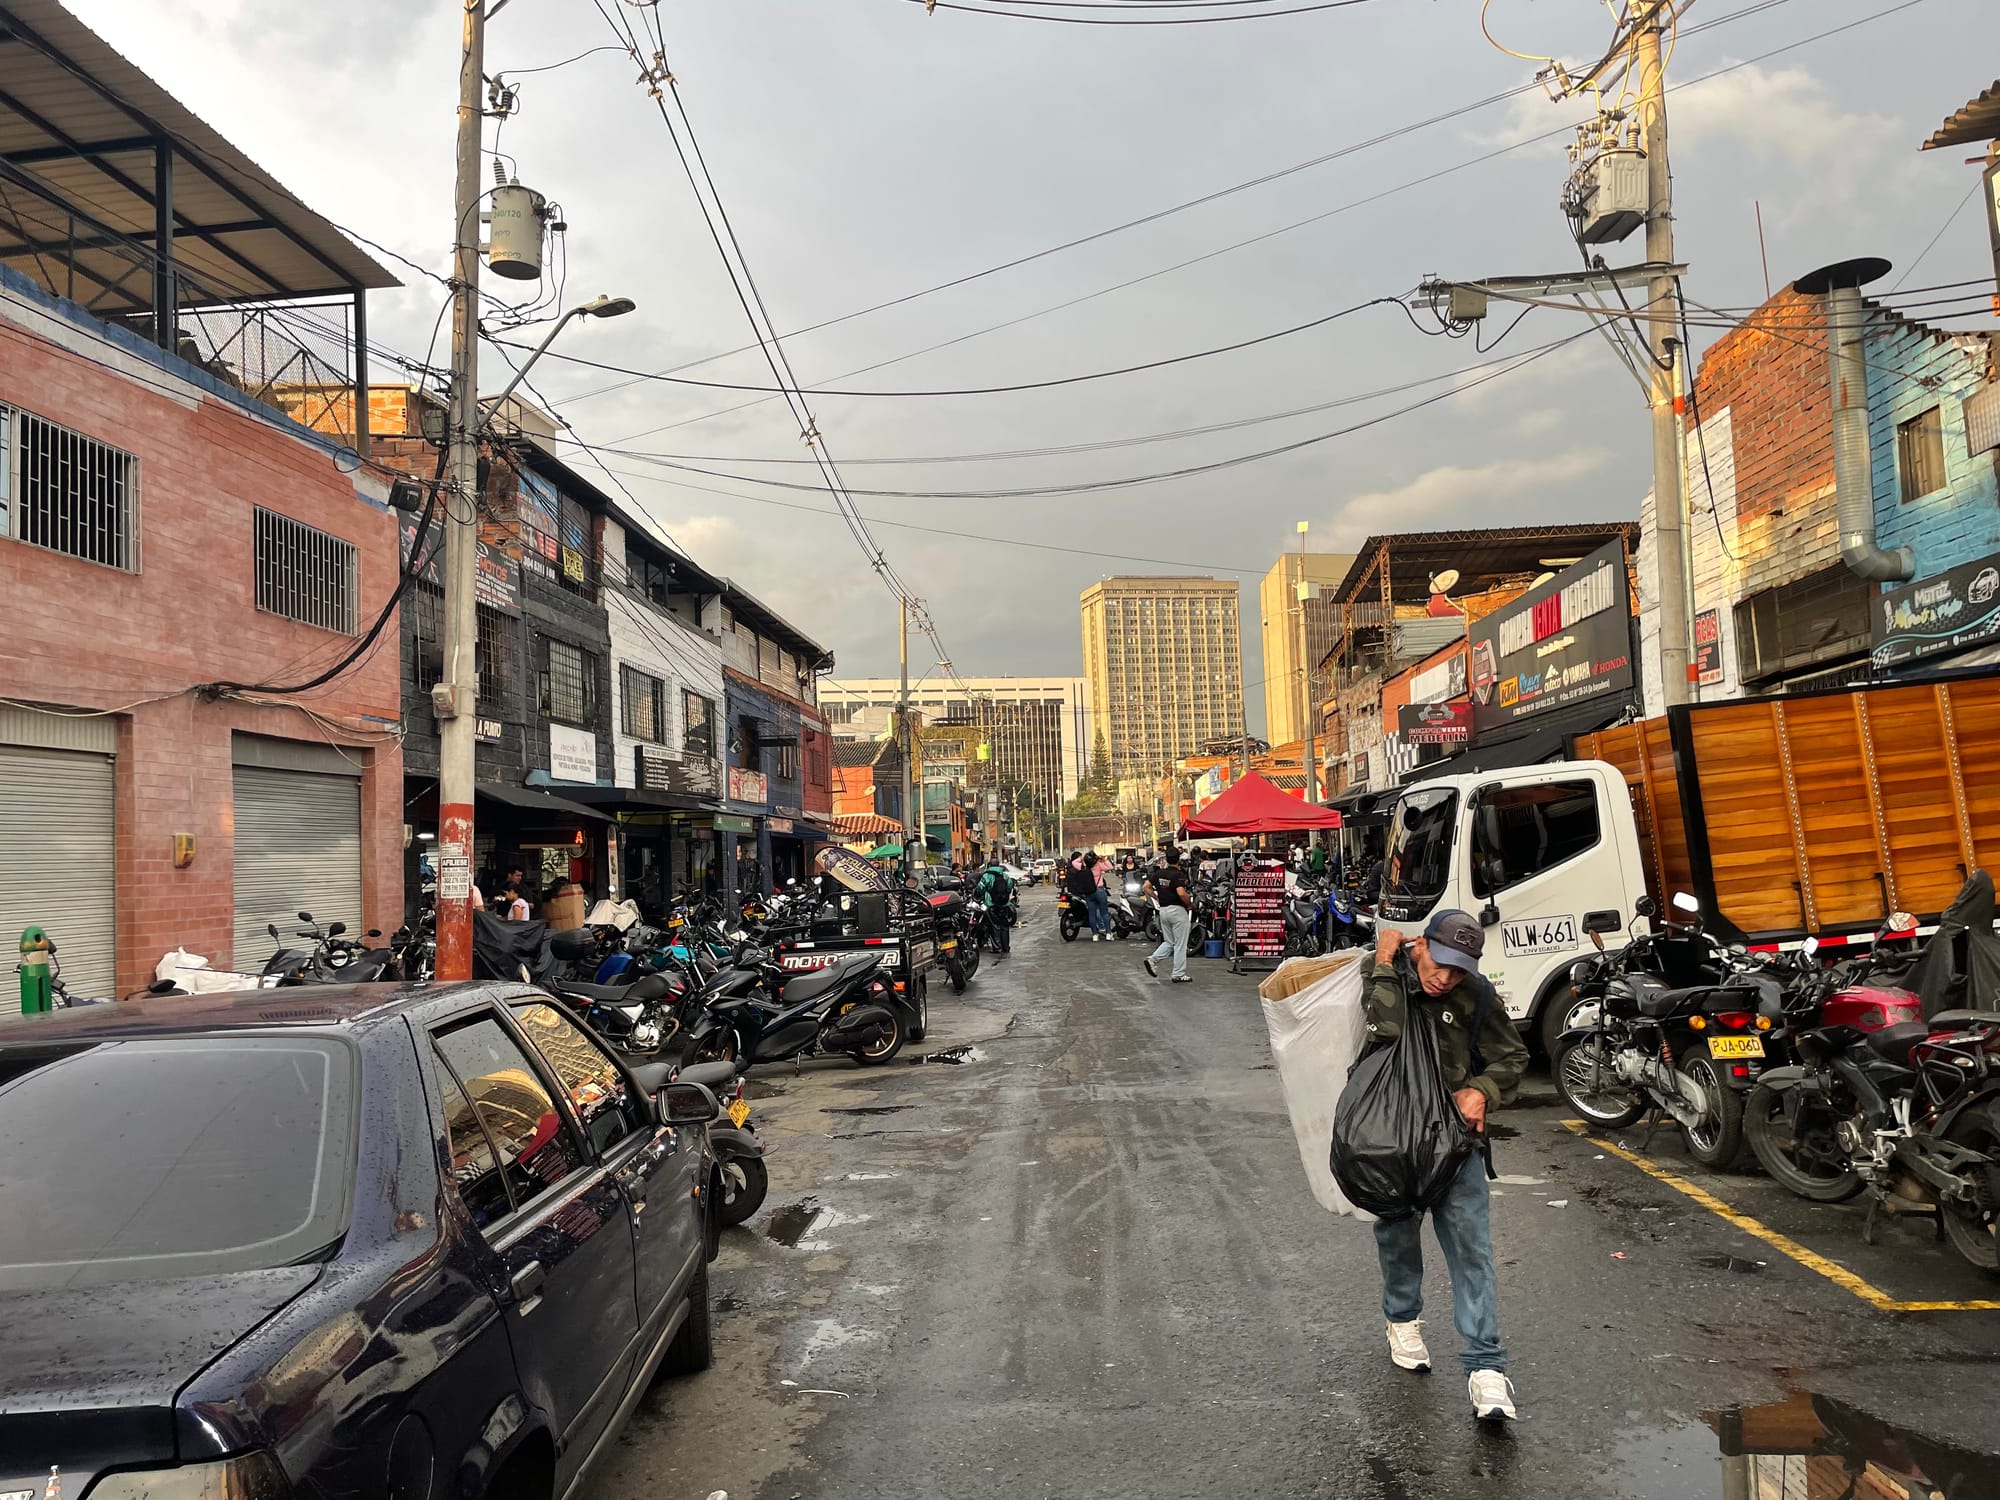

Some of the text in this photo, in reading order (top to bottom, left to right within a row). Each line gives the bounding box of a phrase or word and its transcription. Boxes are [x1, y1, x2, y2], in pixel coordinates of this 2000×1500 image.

[1568, 661, 1591, 685] YAMAHA
[1600, 656, 1628, 674] HONDA
[1502, 681, 1518, 704] KTM
[477, 719, 502, 739] A PUNTO
[1409, 732, 1468, 744] MEDELLIN
[840, 864, 876, 889] PUESTA
[844, 857, 878, 878] TALLER
[1236, 877, 1283, 887] MEDELLIN
[1503, 920, 1576, 949] NLW-661
[1523, 945, 1561, 954] ENVIGADO
[1511, 1005, 1521, 1013] XL
[1712, 1039, 1761, 1053] PJA-06D
